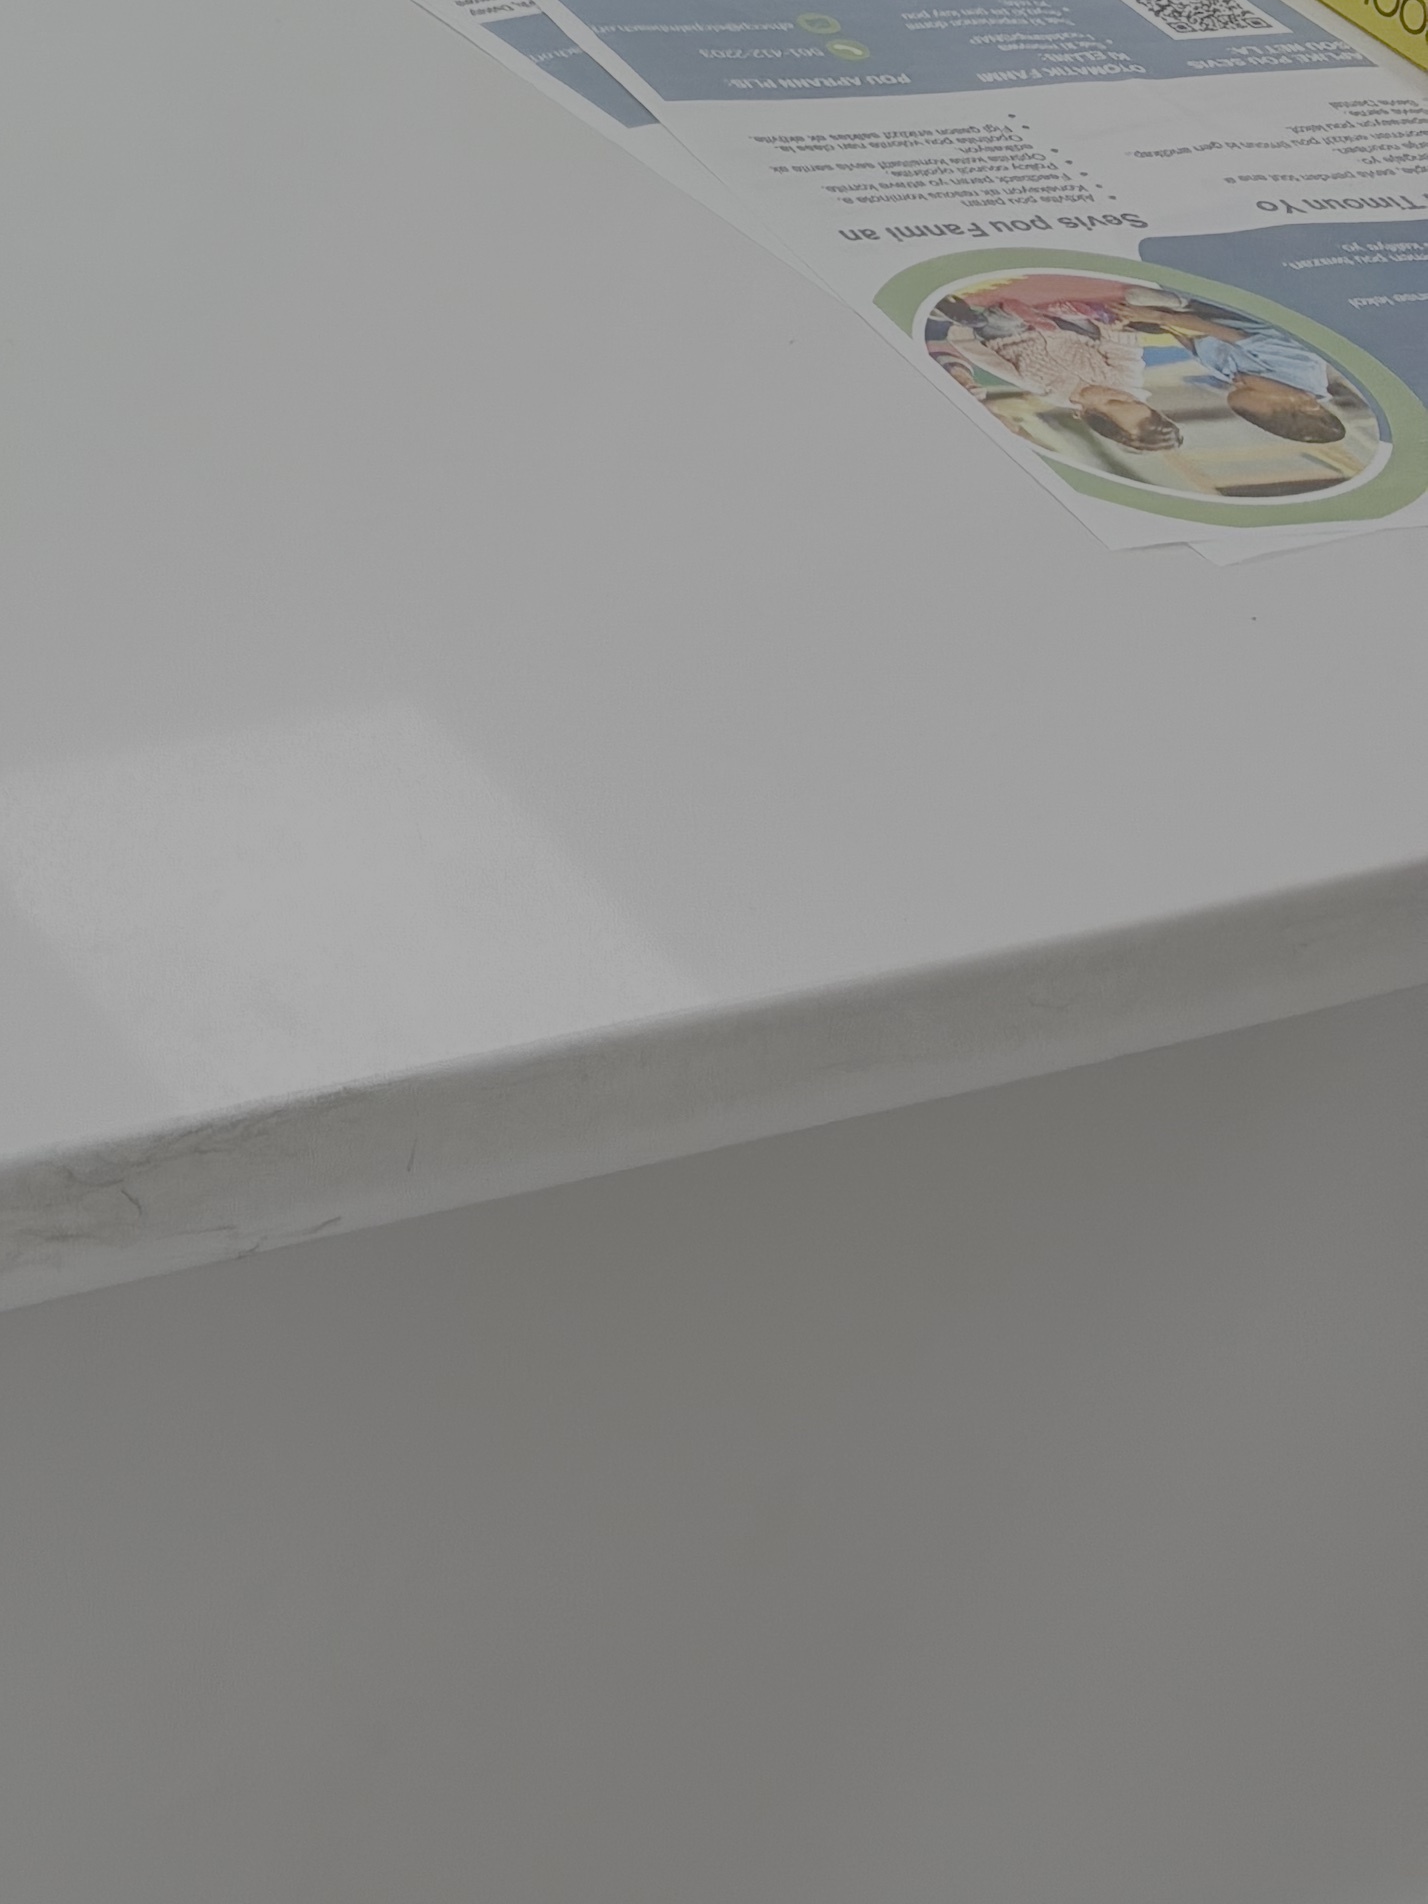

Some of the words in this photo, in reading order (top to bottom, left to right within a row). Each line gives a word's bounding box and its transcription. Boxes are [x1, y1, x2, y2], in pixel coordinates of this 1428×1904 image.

[865, 72, 912, 86] POU
[1255, 198, 1308, 215] Yo
[1301, 194, 1424, 212] Timoun
[989, 214, 1054, 235] pou
[1056, 212, 1149, 232] Sevis
[837, 227, 881, 243] an
[884, 221, 991, 243] Fanmi
